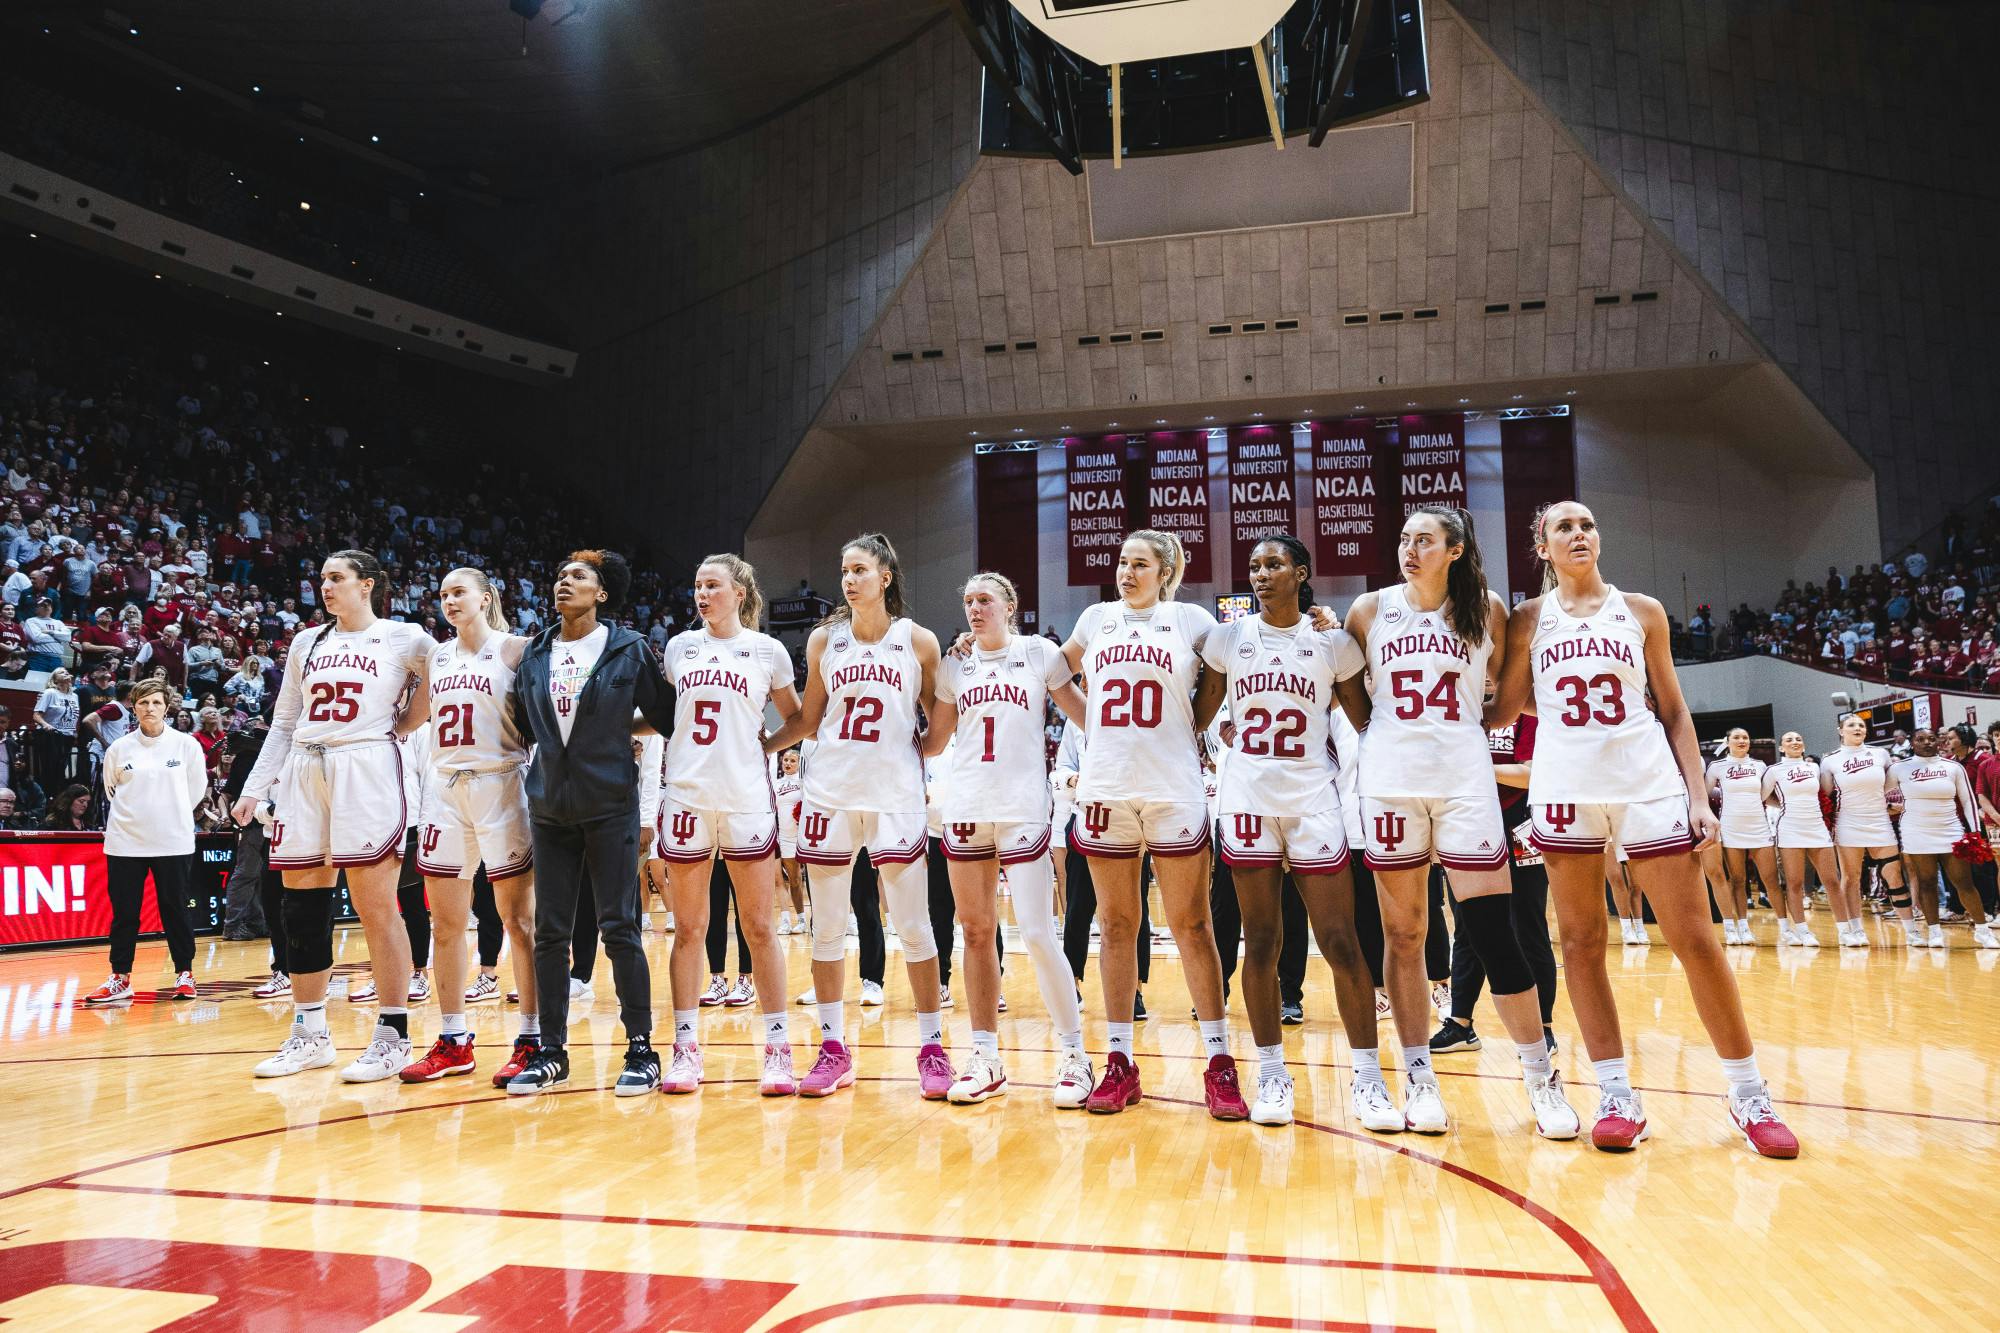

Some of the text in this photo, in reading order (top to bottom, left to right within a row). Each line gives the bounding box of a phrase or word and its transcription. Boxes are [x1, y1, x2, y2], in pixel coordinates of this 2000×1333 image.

[1323, 438, 1366, 453] INDIANA
[1409, 433, 1454, 449] INDIANA
[1157, 449, 1198, 463] INDIANA
[1240, 444, 1281, 459] INDIANA
[1403, 449, 1460, 467] UNIVERSITY
[1076, 453, 1116, 468] INDIANA
[1233, 459, 1288, 476] UNIVERSITY
[1316, 455, 1373, 471] UNIVERSITY
[1071, 469, 1122, 484] UNIVERSITY
[1151, 465, 1204, 480] UNIVERSITY
[1316, 475, 1376, 498] NCAA
[1401, 471, 1464, 496] NCAA
[1070, 489, 1125, 511] NCAA
[1150, 485, 1207, 508] NCAA
[1232, 480, 1291, 504] NCAA
[1234, 508, 1290, 524] BASKETBALL
[1318, 503, 1375, 519] BASKETBALL
[1071, 516, 1123, 531] BASKETBALL
[1151, 513, 1205, 528] BASKETBALL
[1321, 521, 1373, 536] CHAMPIONS
[1073, 532, 1122, 547] CHAMPIONS
[1237, 525, 1288, 540] CHAMPIONS
[1337, 542, 1359, 557] 1981
[1086, 553, 1110, 567] 1940
[773, 601, 806, 614] INDIANA
[1218, 597, 1252, 610] 20:00
[1381, 634, 1471, 666] INDIANA
[1541, 637, 1635, 673] INDIANA
[1096, 645, 1172, 675] INDIANA
[431, 674, 493, 698] NDIANA
[678, 669, 748, 698] INDIANA
[832, 664, 902, 693] INDIANA
[1236, 672, 1316, 704] INDIANA
[1391, 670, 1461, 721] 54
[309, 681, 364, 723] 25
[959, 684, 1029, 716] INDIANA
[1101, 678, 1163, 729] 20
[1555, 673, 1627, 727] 33
[438, 703, 476, 748] 21
[692, 701, 721, 746] 5
[838, 696, 884, 743] 12
[981, 717, 995, 762] 1
[1241, 707, 1307, 758] 22
[1842, 757, 1874, 773] Indiana
[1911, 767, 1948, 780] Indiana
[3, 864, 86, 916] IN!
[341, 888, 348, 899] 5
[209, 896, 217, 909] 5
[342, 904, 350, 916] 2
[210, 913, 218, 926] 3
